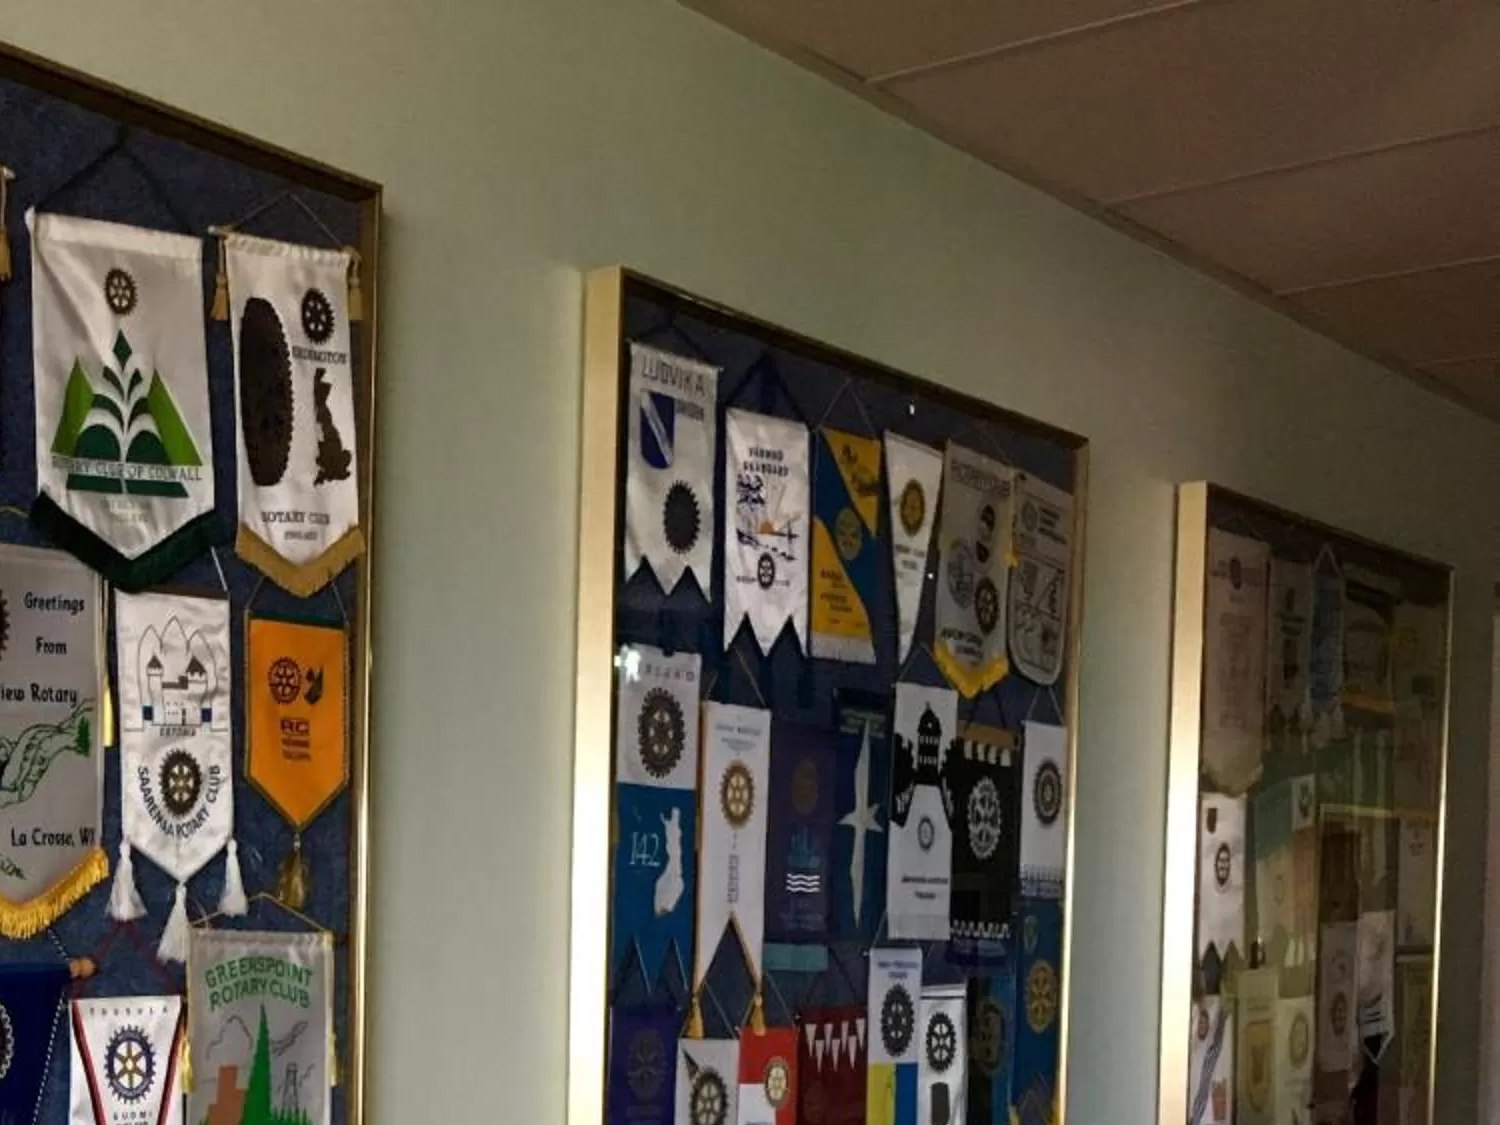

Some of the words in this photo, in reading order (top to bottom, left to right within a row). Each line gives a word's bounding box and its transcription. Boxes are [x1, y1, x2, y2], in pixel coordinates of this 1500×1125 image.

[642, 354, 706, 398] LUDVIKA
[24, 592, 85, 614] Greetings
[36, 637, 67, 655] From
[31, 683, 78, 708] Rotary
[205, 765, 221, 804] CLUB
[11, 828, 26, 846] La
[205, 956, 313, 989] GREENSPOINT
[210, 977, 267, 1012] ROTARY
[269, 979, 311, 1008] CLUB
